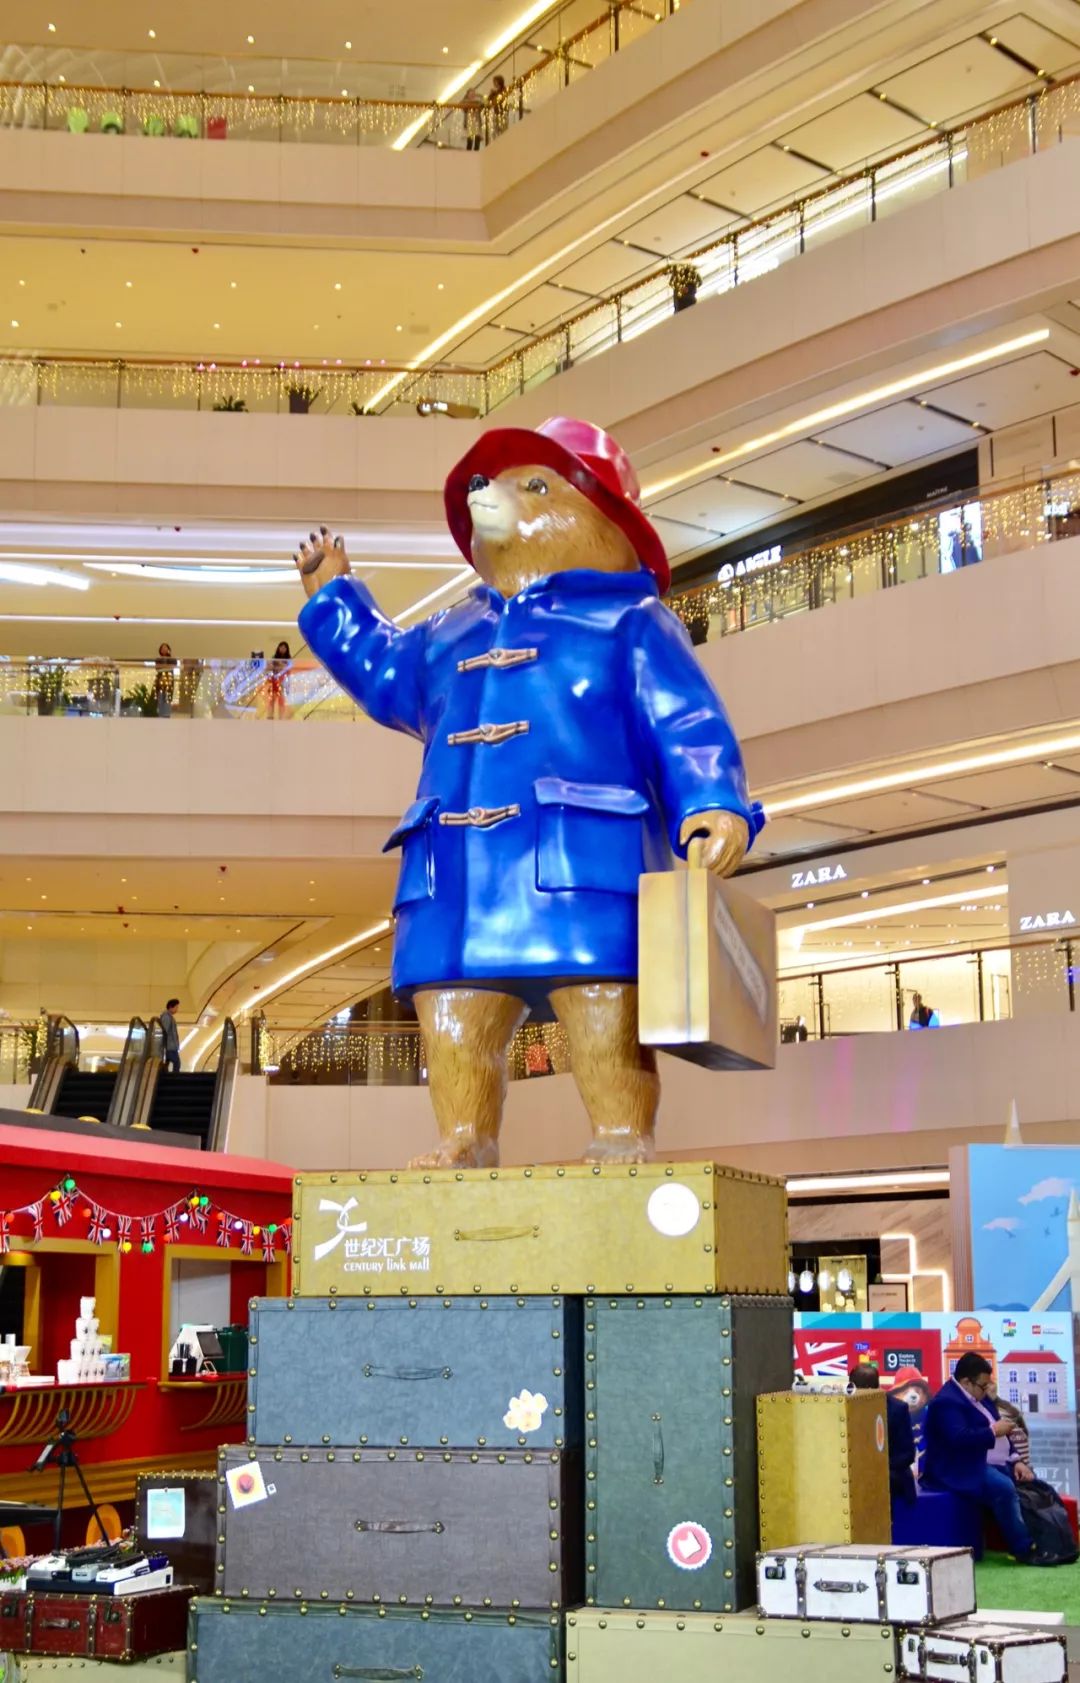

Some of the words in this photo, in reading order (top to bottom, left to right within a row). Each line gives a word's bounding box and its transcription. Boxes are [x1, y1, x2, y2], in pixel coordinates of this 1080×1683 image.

[791, 864, 848, 888] ZARA
[1020, 910, 1076, 930] ZARA
[344, 1236, 431, 1258] 世纪汇广场
[343, 1262, 384, 1272] CENTURY
[887, 1353, 897, 1368] 9
